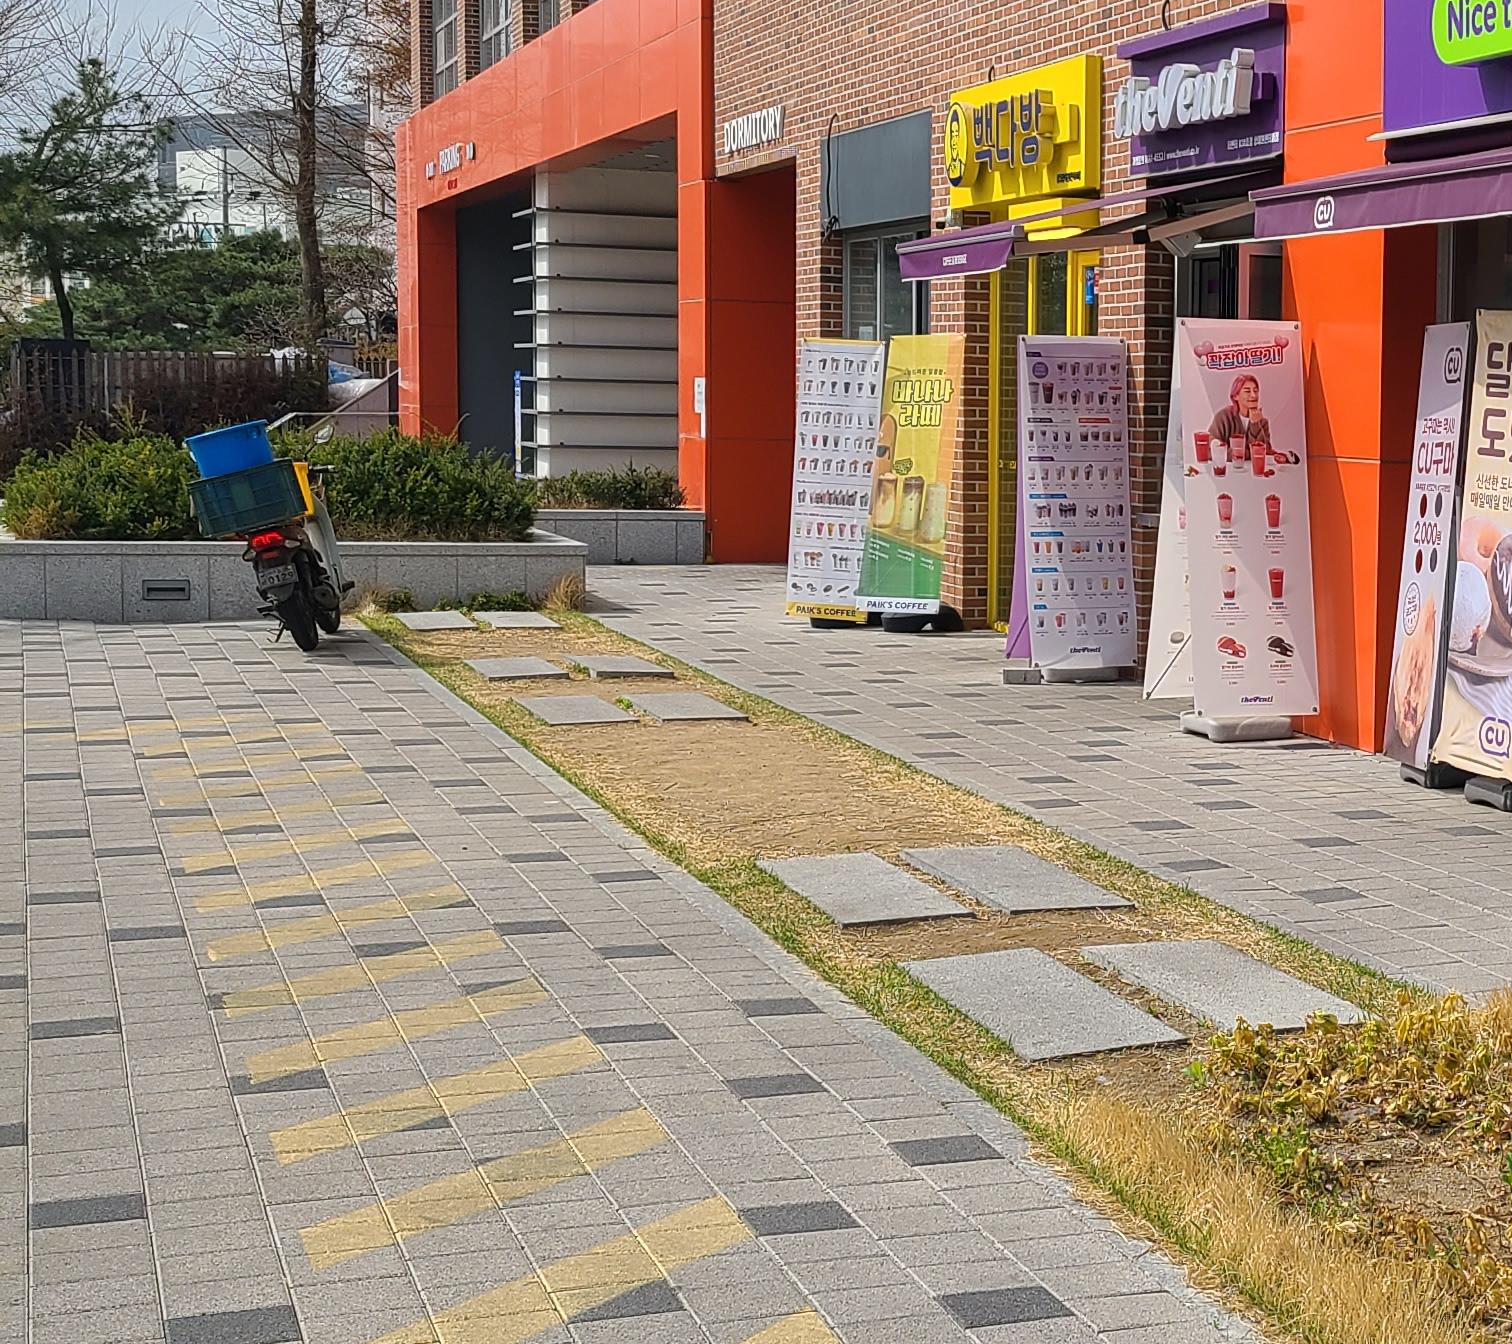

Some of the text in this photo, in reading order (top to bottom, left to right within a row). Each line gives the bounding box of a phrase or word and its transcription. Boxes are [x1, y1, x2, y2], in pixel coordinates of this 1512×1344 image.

[723, 104, 784, 154] DORMITORY
[973, 89, 1042, 173] 빽다방
[1317, 203, 1331, 222] CU
[1447, 355, 1461, 375] CU
[892, 379, 954, 404] 바나나
[899, 403, 943, 427] 라떼
[1417, 440, 1455, 476] CU구마
[1476, 474, 1499, 492] 신선한
[1470, 492, 1500, 511] 매일매일
[795, 605, 857, 617] PAIK'S COFFEE
[866, 600, 929, 610] PAIK'S COFFEE
[1485, 725, 1506, 747] CU
